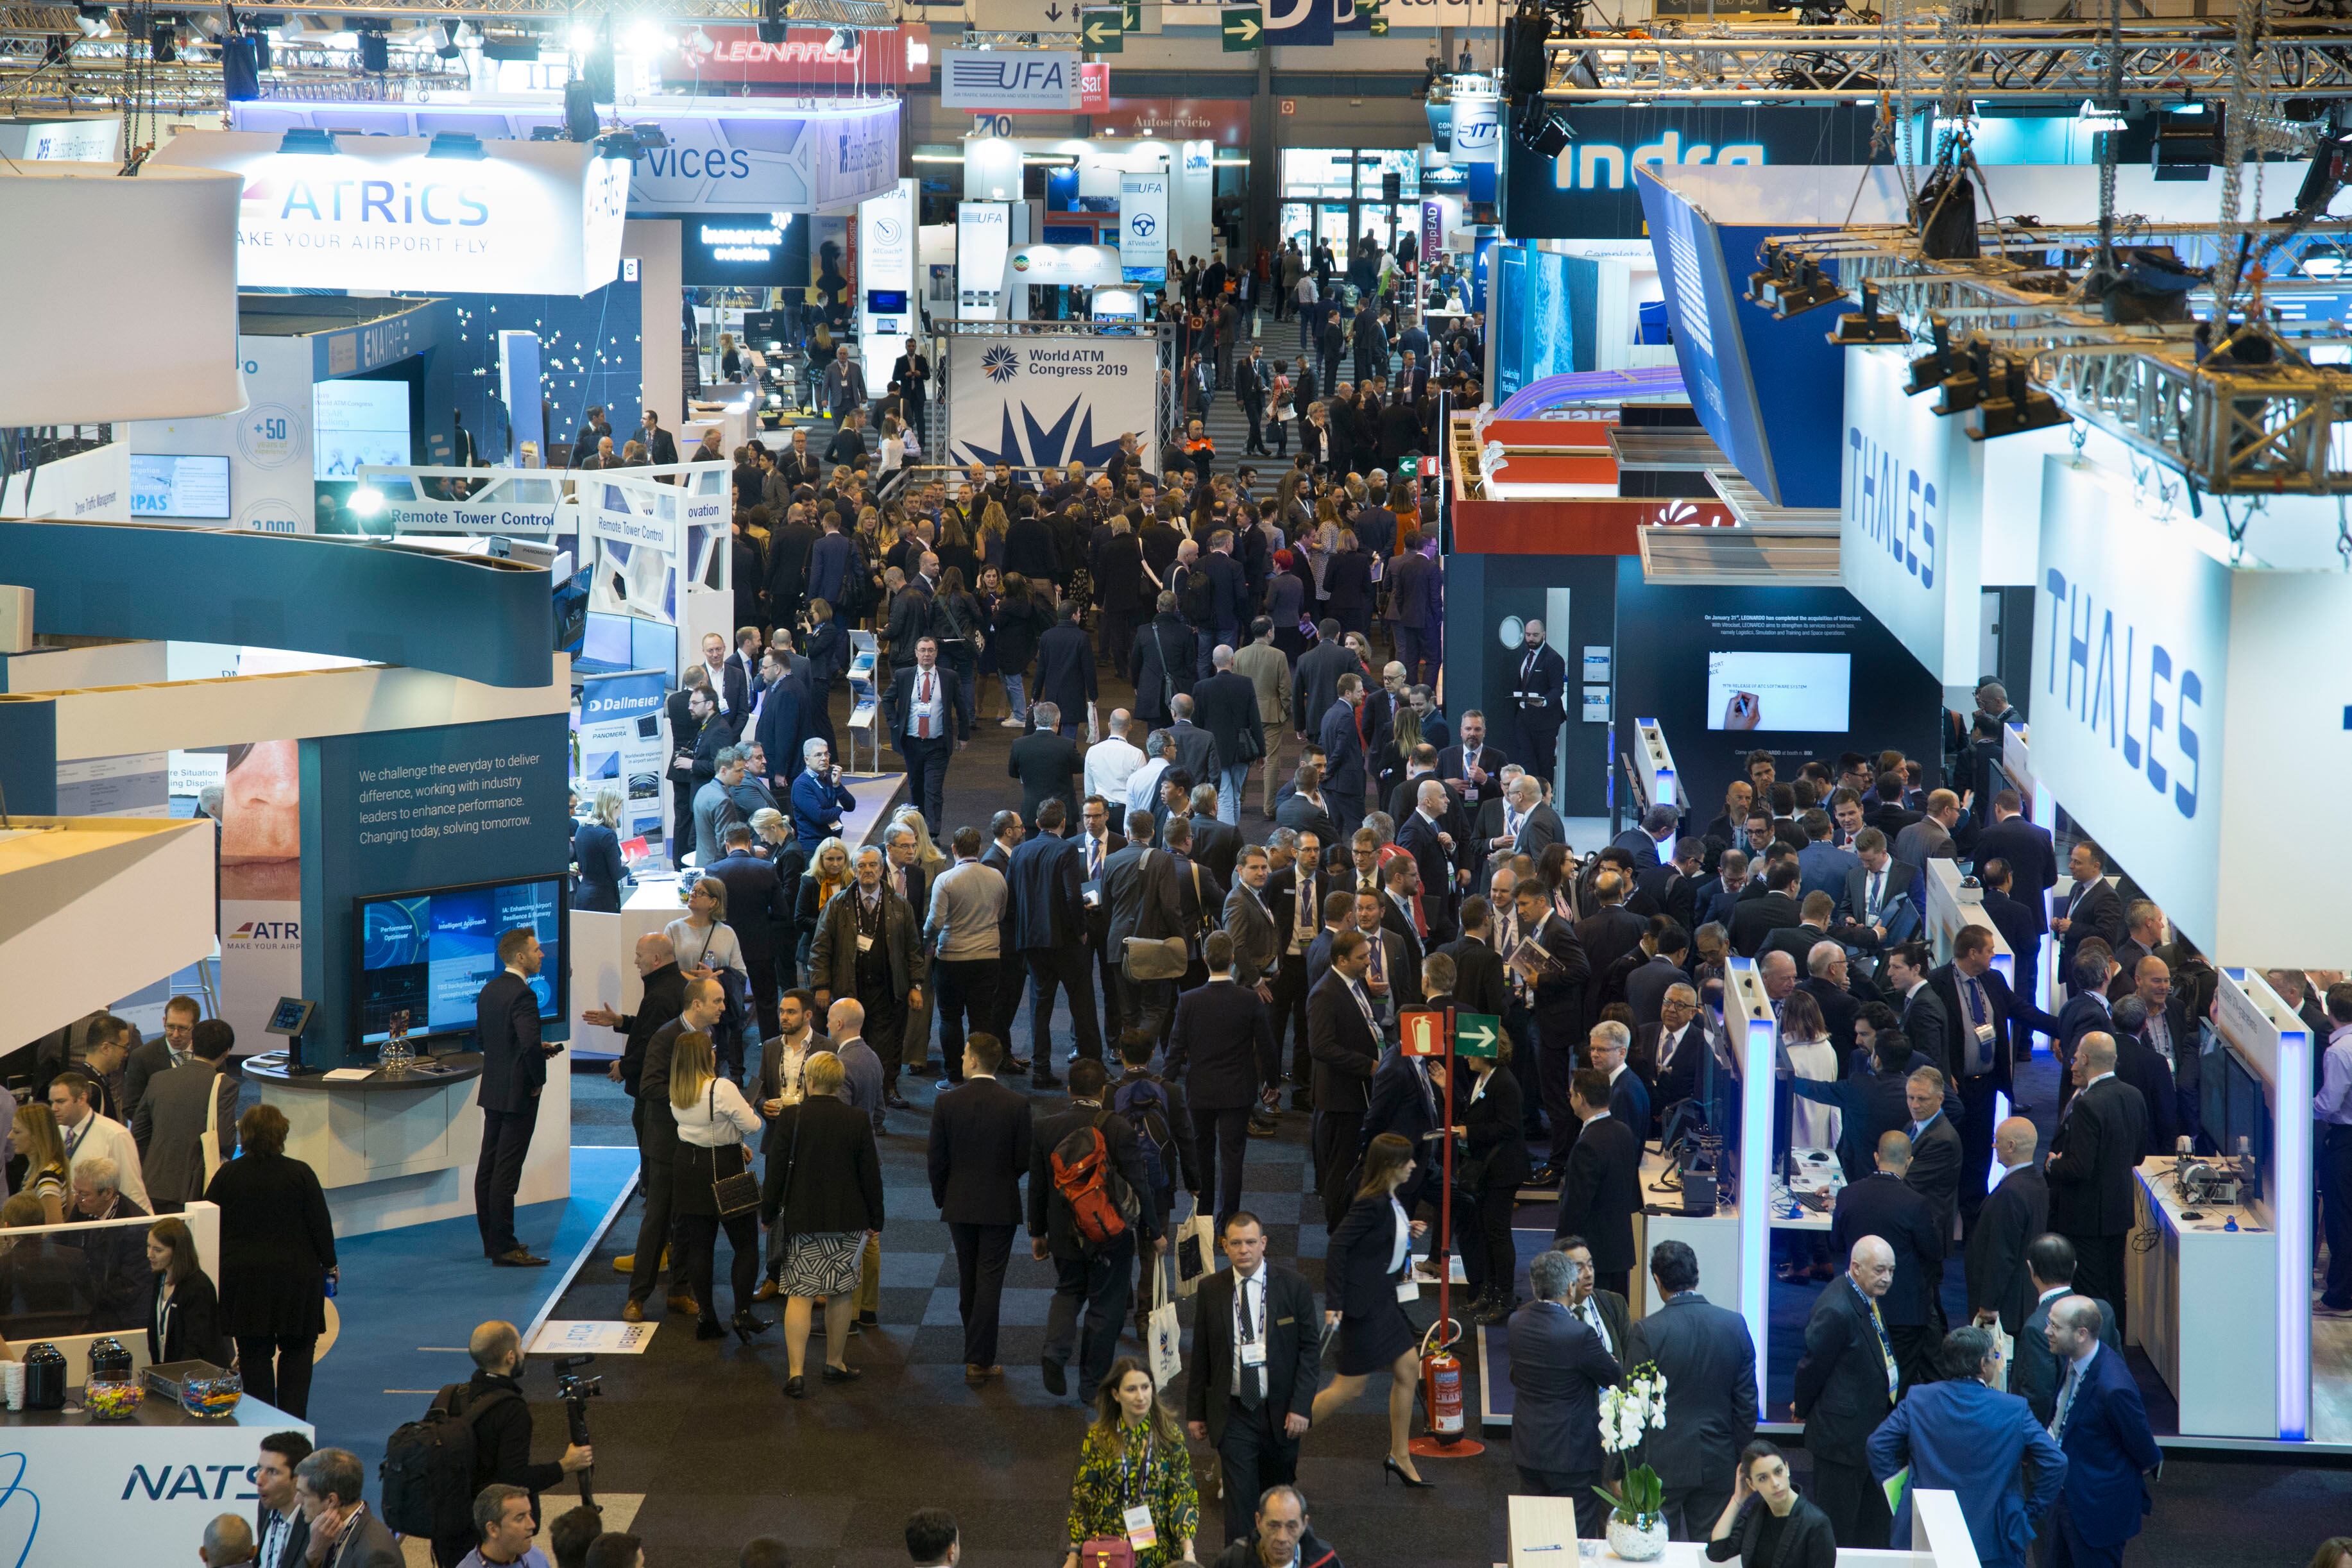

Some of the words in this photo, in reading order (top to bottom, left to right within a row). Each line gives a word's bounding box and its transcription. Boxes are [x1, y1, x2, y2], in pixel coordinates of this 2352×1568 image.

[713, 40, 861, 63] LEONARDO
[999, 62, 1063, 89] UFA
[1138, 183, 1163, 193] UFA
[978, 212, 1003, 224] UFA
[284, 232, 341, 250] YOUR
[351, 235, 443, 253] AIRPORT
[455, 238, 489, 254] FLY
[701, 225, 783, 246] inmarsat
[713, 246, 770, 262] aviation
[1029, 349, 1070, 361] World
[1072, 350, 1104, 362] ATM
[1029, 362, 1093, 377] Congress
[1096, 364, 1128, 376] 2019
[688, 504, 719, 518] ovation
[1849, 425, 1936, 590] THALES
[391, 509, 448, 523] Remote
[453, 511, 497, 524] Tower
[502, 511, 554, 525] Control
[599, 516, 621, 533] Remote
[622, 521, 640, 540] Tower
[642, 525, 664, 541] Control
[2047, 567, 2203, 819] THALES
[603, 696, 659, 711] Dallmeier
[359, 770, 376, 782] We
[378, 765, 427, 781] challenge
[429, 763, 446, 776] the
[448, 758, 493, 774] everyday
[495, 757, 506, 768] to
[507, 753, 540, 767] deliver
[359, 788, 413, 803] difference,
[415, 783, 456, 797] working
[457, 779, 479, 793] with
[481, 776, 522, 790] industry
[359, 809, 397, 824] leaders
[399, 808, 410, 820] to
[412, 803, 456, 818] enhance
[457, 796, 525, 815] performance.
[359, 830, 409, 844] Changing
[411, 825, 441, 839] today,
[443, 821, 479, 835] solving
[481, 815, 533, 831] tomorrow.
[509, 905, 534, 913] Enhancing
[534, 901, 552, 910] Airport
[438, 921, 463, 930] Intelligent
[463, 918, 487, 929] Approach
[502, 914, 527, 922] Resilience
[532, 910, 552, 919] Runway
[253, 922, 300, 939] ATR
[380, 923, 413, 933] Performance
[384, 933, 409, 941] Optimiser
[448, 980, 477, 989] background
[438, 991, 459, 1000] concepts
